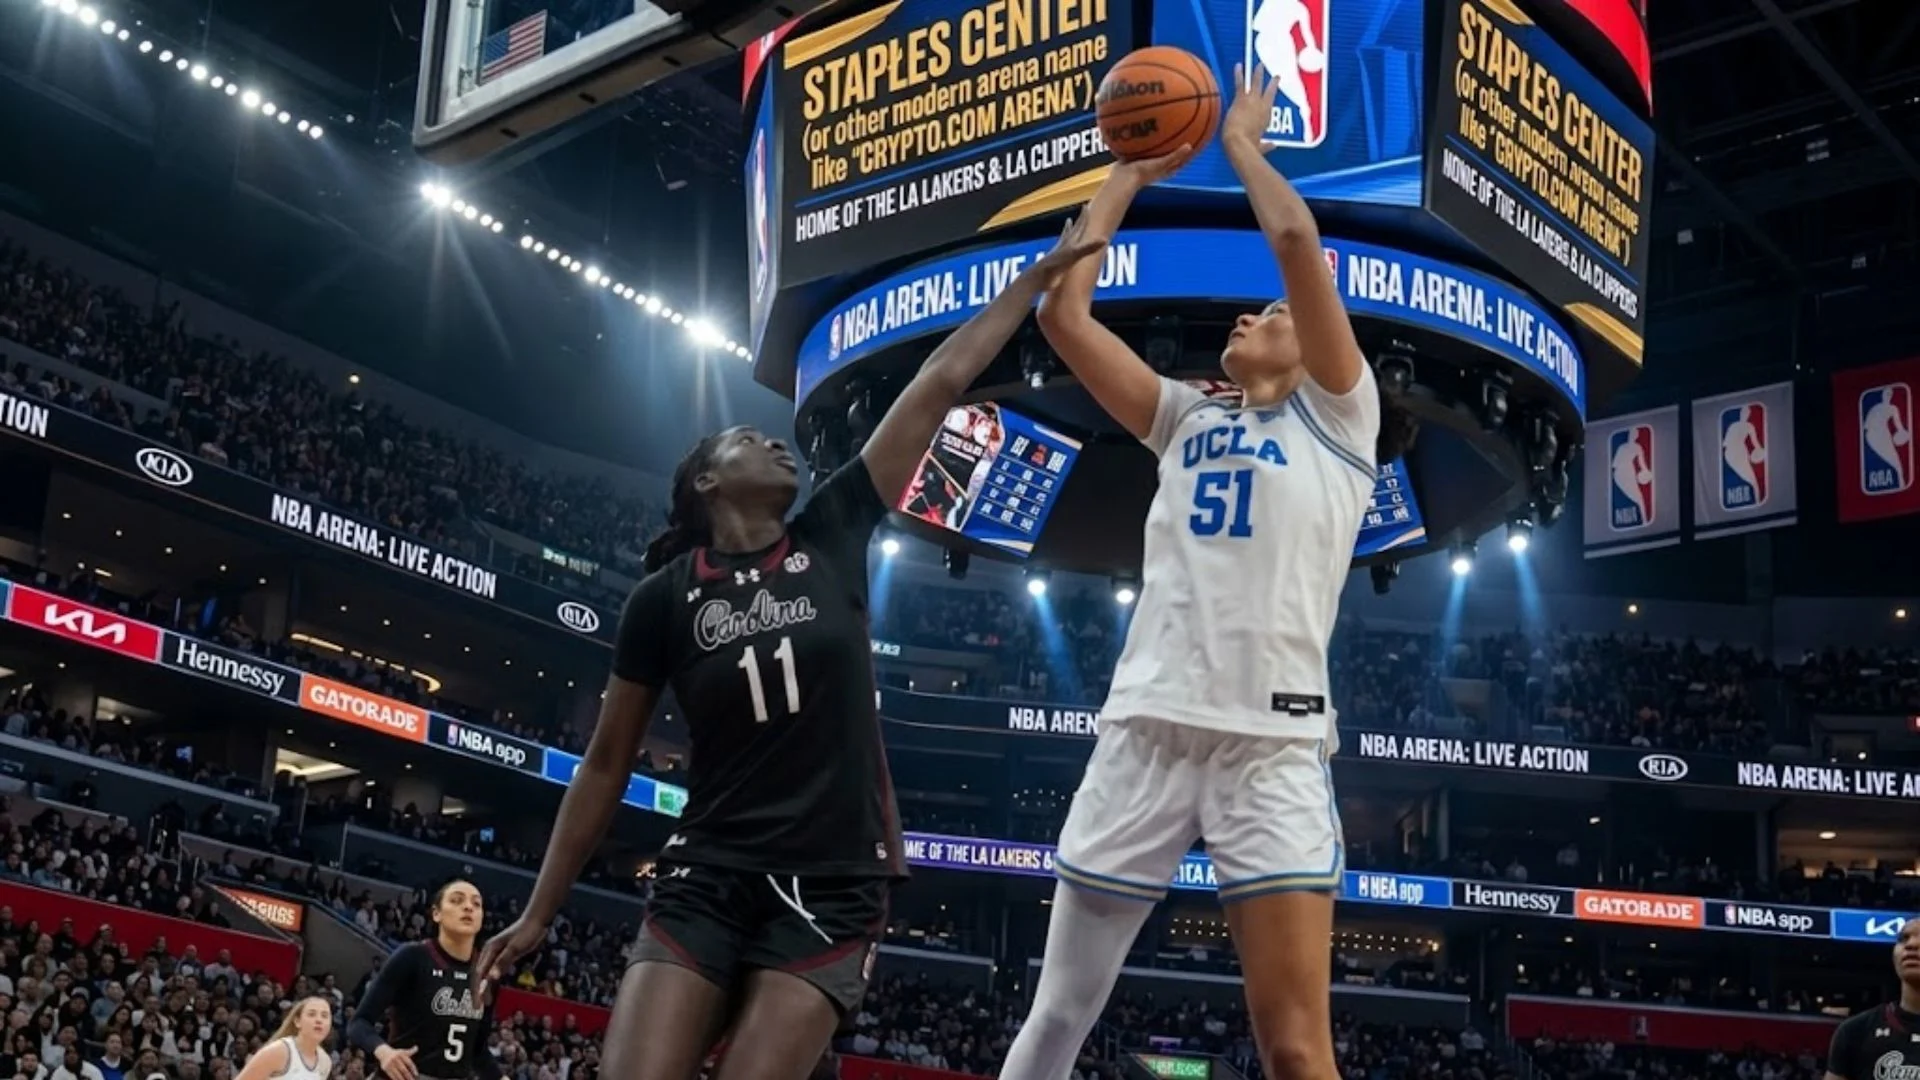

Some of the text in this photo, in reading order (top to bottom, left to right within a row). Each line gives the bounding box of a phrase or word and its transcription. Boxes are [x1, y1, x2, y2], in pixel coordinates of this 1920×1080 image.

[803, 34, 1107, 160] (or other modern arena name
[1266, 106, 1294, 134] BA
[1564, 92, 1643, 203] CENTER
[796, 126, 1111, 242] HOME OF THE LA LAKERS & LA CLIPPER
[811, 155, 848, 190] like
[843, 298, 878, 351] NBA
[881, 271, 962, 325] ARENA:
[1348, 254, 1405, 306] NBA
[1410, 268, 1493, 333] ARENA:
[1497, 298, 1535, 355] LIVE
[1182, 426, 1288, 469] UCLA
[1189, 468, 1253, 538] 51
[271, 493, 312, 534] NBA
[315, 510, 385, 559] ARENA:
[387, 535, 430, 576] LIVE
[431, 552, 497, 600] ACTION
[693, 588, 818, 652] Carolina
[176, 638, 286, 696] Hennessy
[737, 636, 801, 723] 11
[310, 684, 420, 733] GATORADE
[1009, 707, 1046, 732] NBA
[458, 727, 494, 755] NBA
[1360, 733, 1590, 773] NBA ARENA: LIVE ACTION
[1737, 761, 1778, 788] NBA
[1781, 765, 1851, 793] ARENA:
[1854, 770, 1898, 797] LIVE
[946, 843, 970, 864] THE
[970, 845, 988, 866] LA
[990, 847, 1041, 870] LAKERS
[1464, 883, 1560, 914] Hennessy
[1737, 906, 1777, 927] NBA
[443, 1023, 468, 1063] 5
